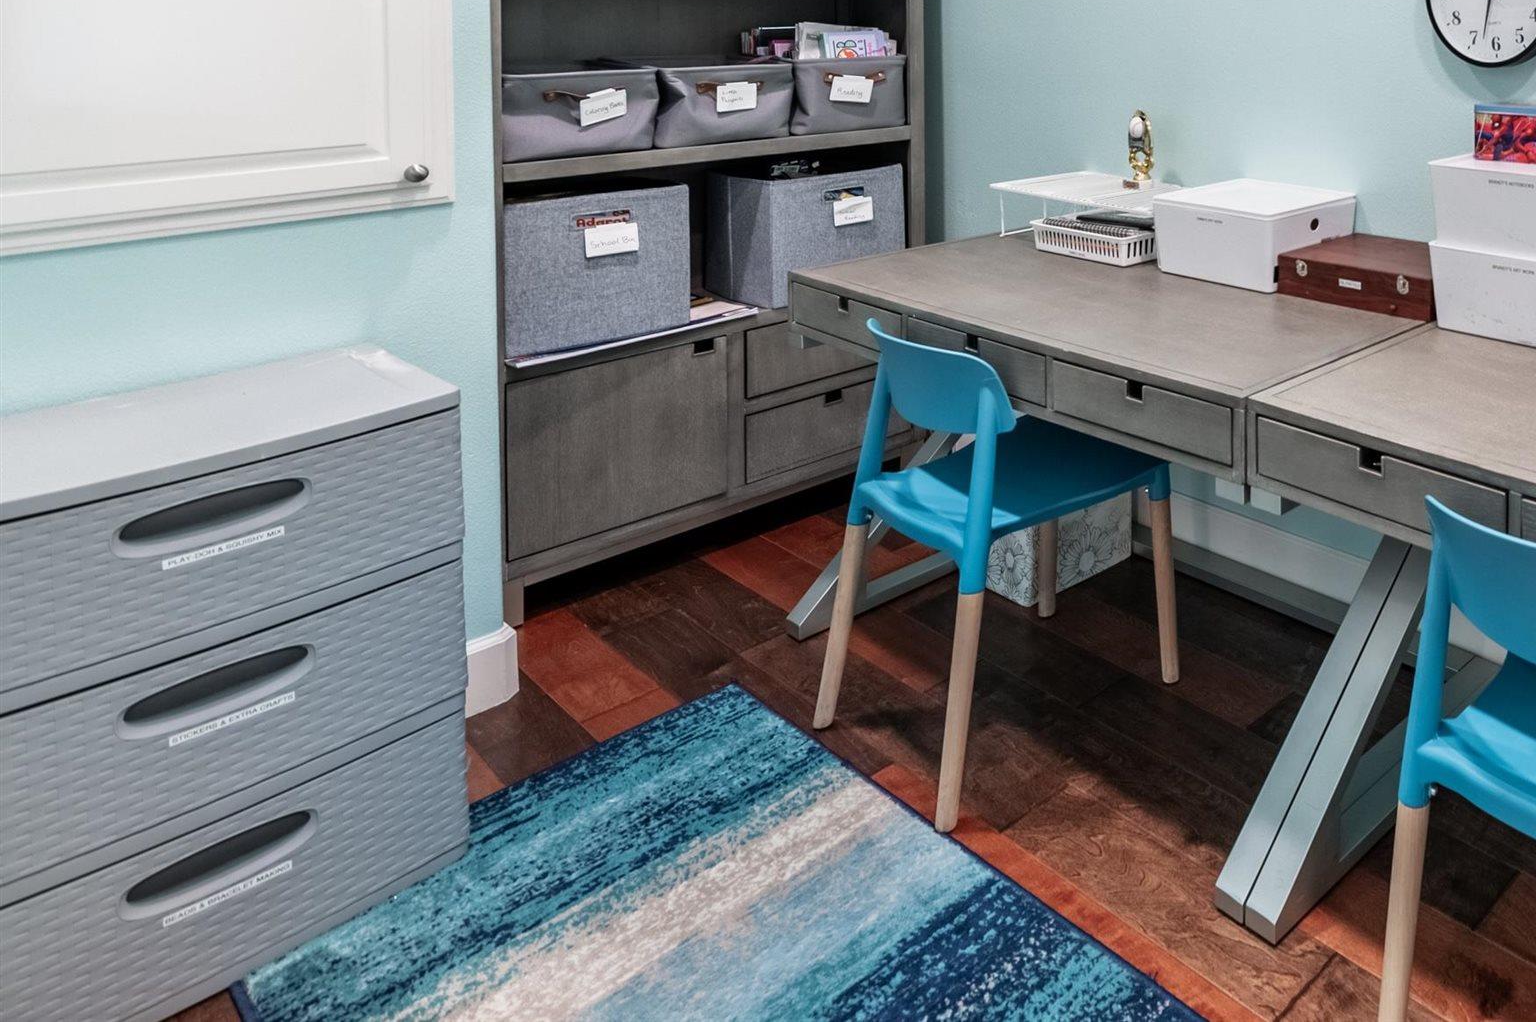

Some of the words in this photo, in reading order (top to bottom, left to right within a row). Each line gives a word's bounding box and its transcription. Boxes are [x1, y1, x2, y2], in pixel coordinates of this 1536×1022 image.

[1451, 10, 1461, 26] 8
[1469, 30, 1479, 46] 7
[1491, 35, 1501, 51] 6
[1515, 27, 1524, 44] 5
[591, 237, 619, 249] School
[267, 529, 281, 538] MIX
[171, 722, 218, 744] STICKERS
[229, 707, 258, 723] EXTRA
[260, 694, 294, 711] CRAFTS
[164, 906, 198, 925] BEADS
[207, 880, 254, 907] BRACELET
[256, 863, 291, 883] MAKING
